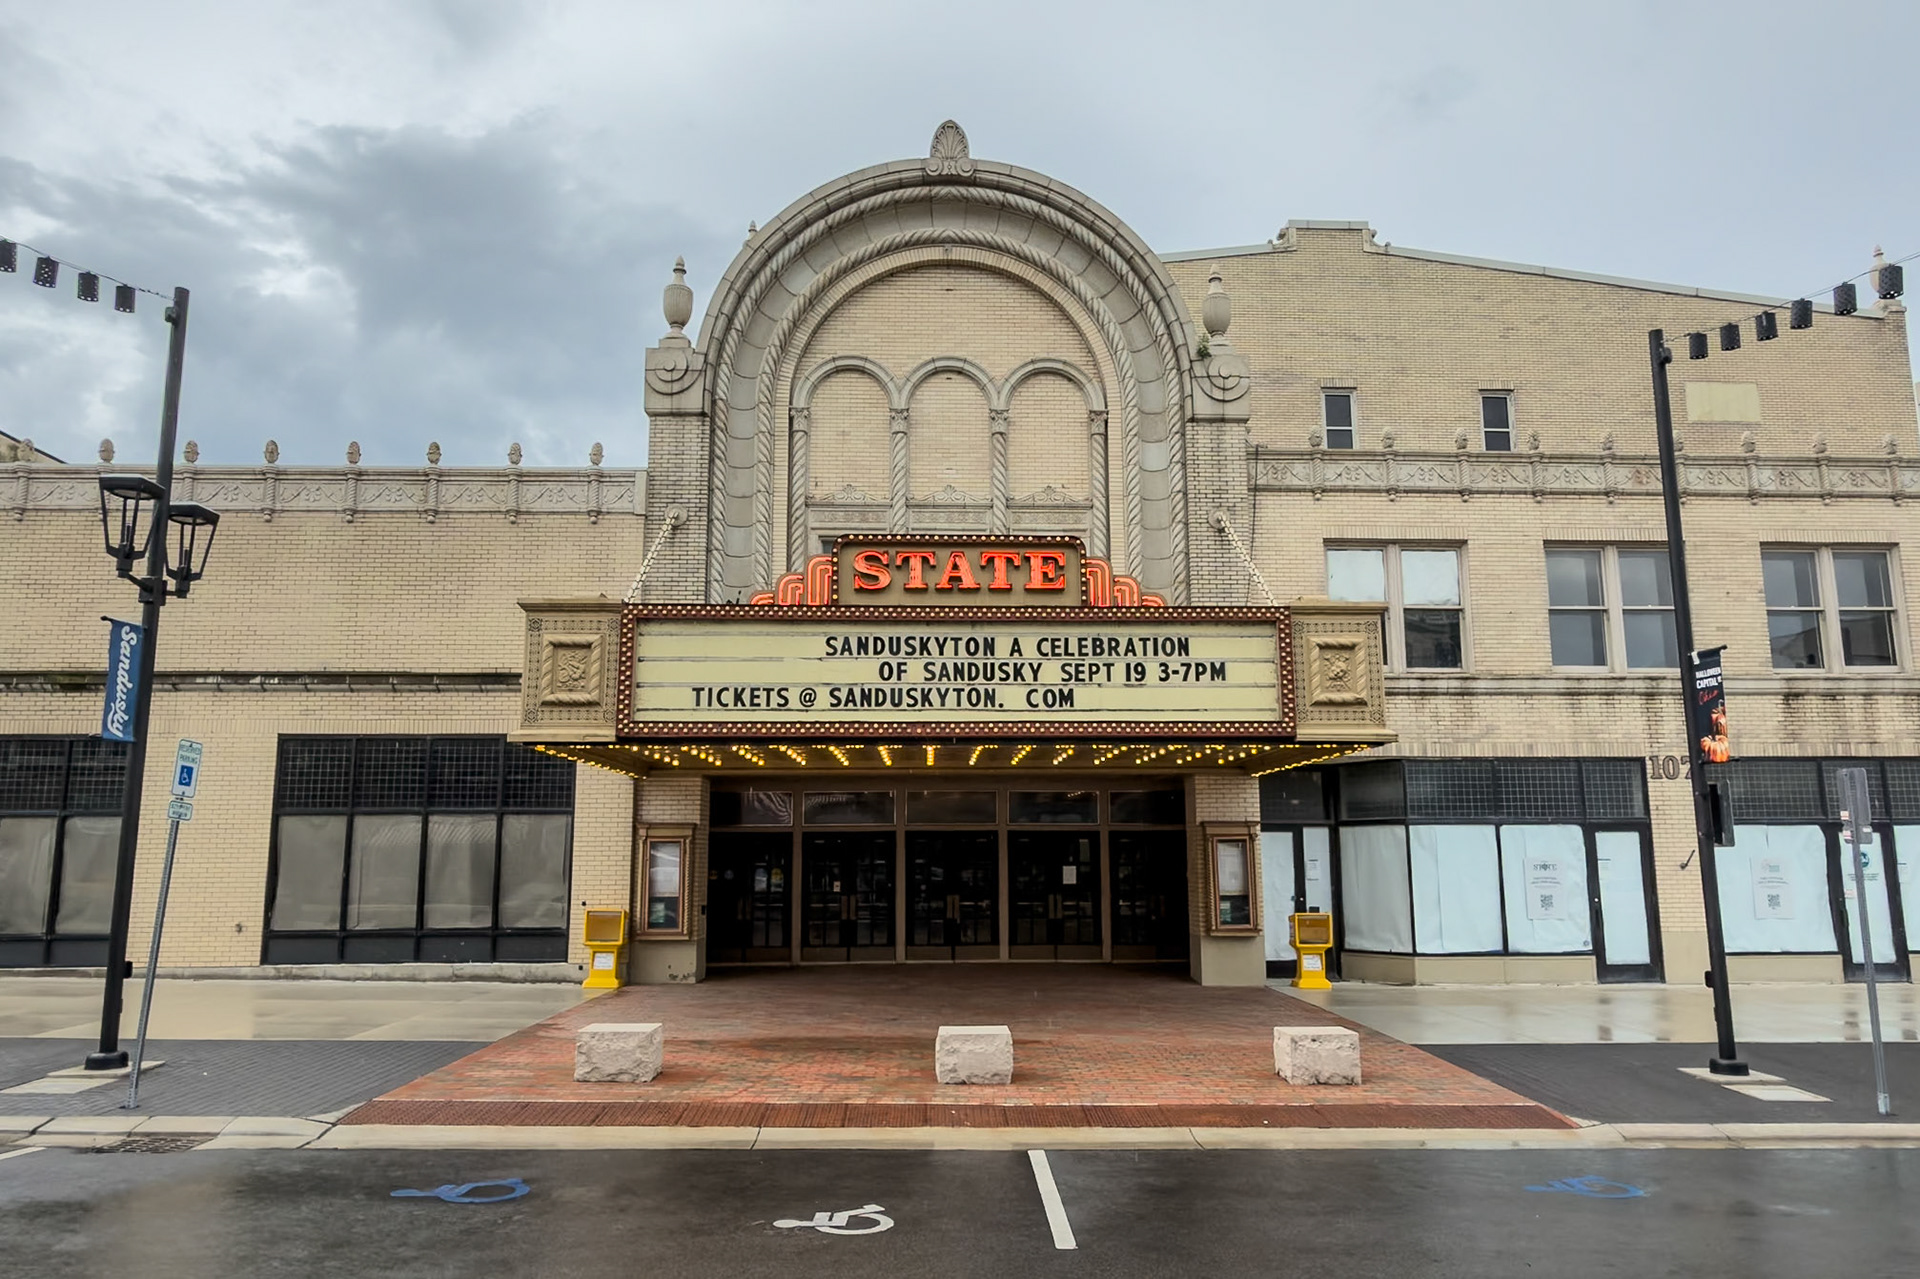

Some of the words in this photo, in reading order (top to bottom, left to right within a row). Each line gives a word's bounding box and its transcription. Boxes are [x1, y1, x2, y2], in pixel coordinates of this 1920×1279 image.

[853, 550, 1067, 590] STATE
[826, 636, 996, 657] SANDUSKYTON
[1010, 637, 1024, 658] A
[1036, 637, 1190, 658] CELEBRATION
[107, 625, 137, 738] Sandusky
[879, 661, 908, 682] OF
[923, 661, 1043, 683] SANDUSKY
[1060, 662, 1115, 683] SEPT
[1125, 662, 1147, 683] 19
[1158, 661, 1227, 683] 3-7PM
[692, 686, 790, 708] TICKETS
[798, 687, 817, 708] @
[828, 687, 1004, 709] SANDUSKYTON.
[1026, 687, 1075, 709] COM
